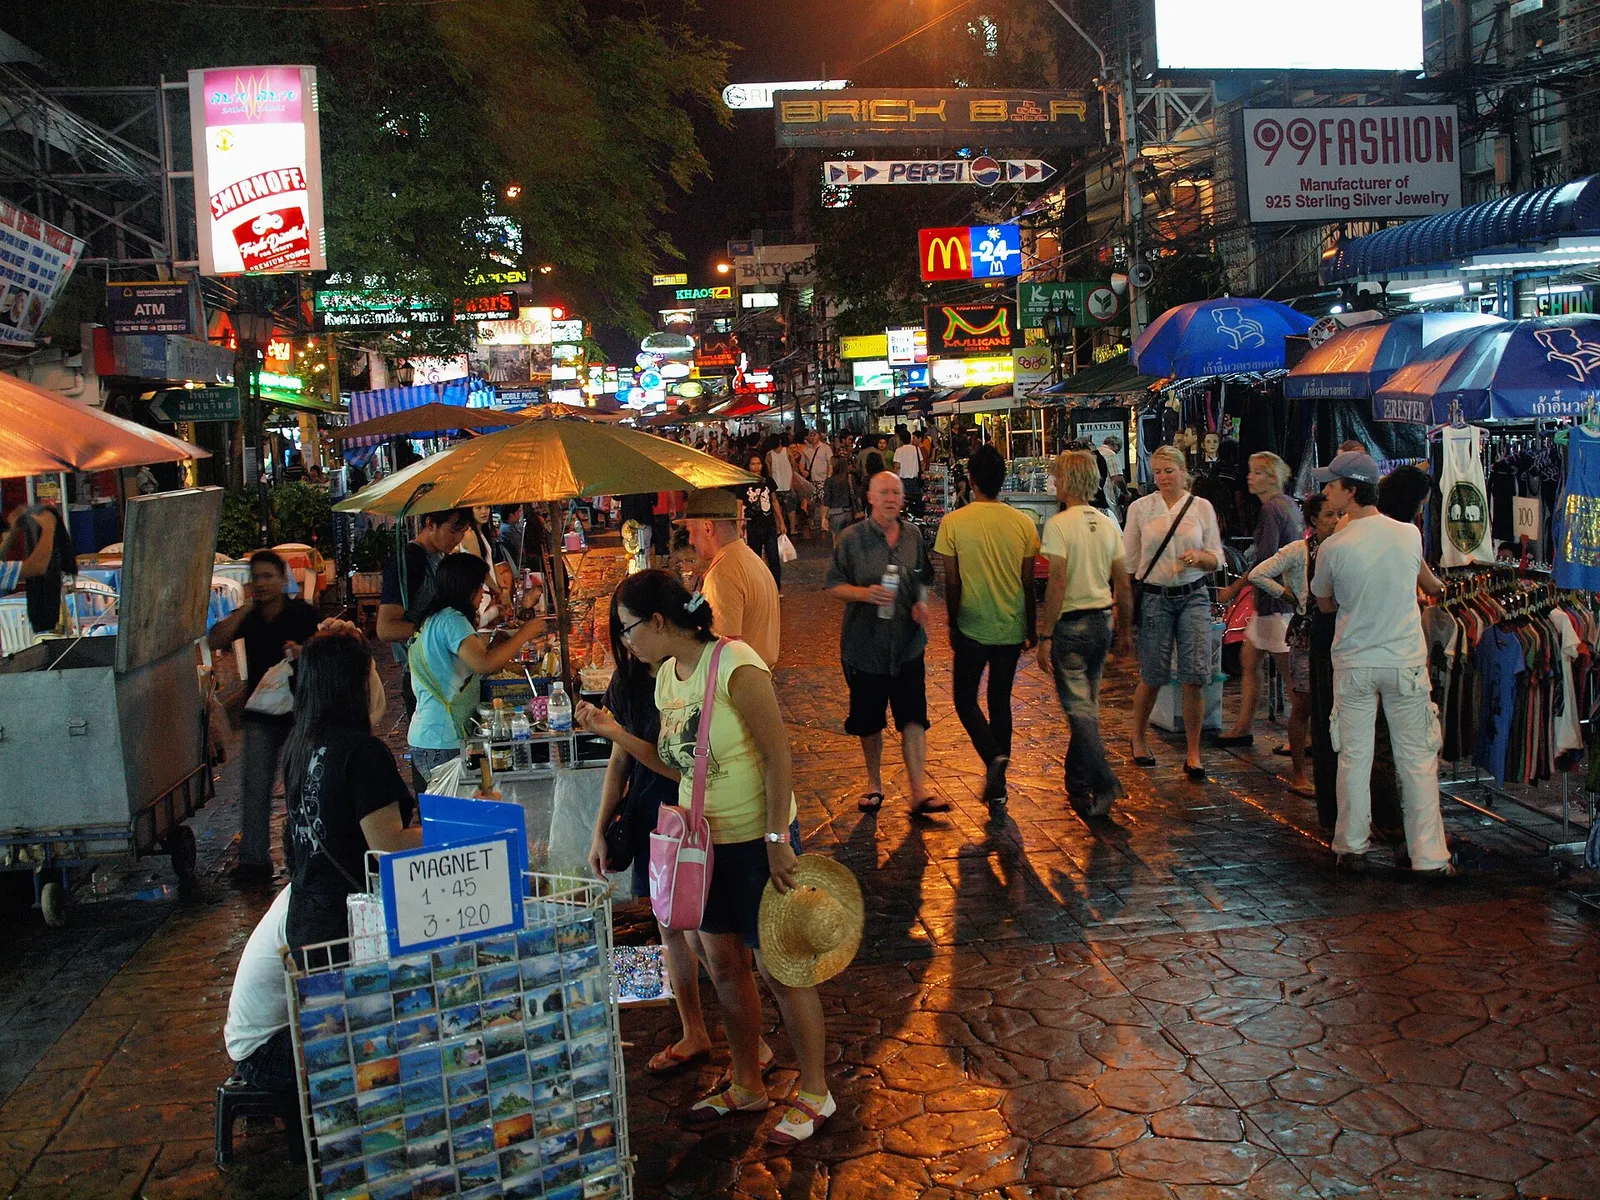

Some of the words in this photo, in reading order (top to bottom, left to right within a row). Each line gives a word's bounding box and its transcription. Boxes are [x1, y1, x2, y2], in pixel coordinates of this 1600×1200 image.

[781, 100, 947, 123] BRICK
[888, 162, 963, 183] PEPSI
[1300, 177, 1392, 191] Manufacturer
[1395, 175, 1410, 189] of
[1265, 194, 1292, 208] 925
[1295, 192, 1351, 210] Sterling
[1353, 192, 1392, 207] Silver
[1395, 190, 1449, 207] Jewelry
[249, 256, 284, 271] PREMIUM
[284, 248, 311, 261] VODKA
[979, 240, 1008, 262] 24
[1031, 285, 1049, 302] K
[1052, 290, 1075, 300] ATM
[134, 303, 166, 316] ATM
[943, 337, 1011, 348] MULLIGANS
[502, 392, 520, 400] MOBILE
[522, 391, 539, 399] PHONE
[1079, 423, 1109, 431] WHATS
[1517, 507, 1534, 527] 100
[410, 848, 493, 882] MAGNET
